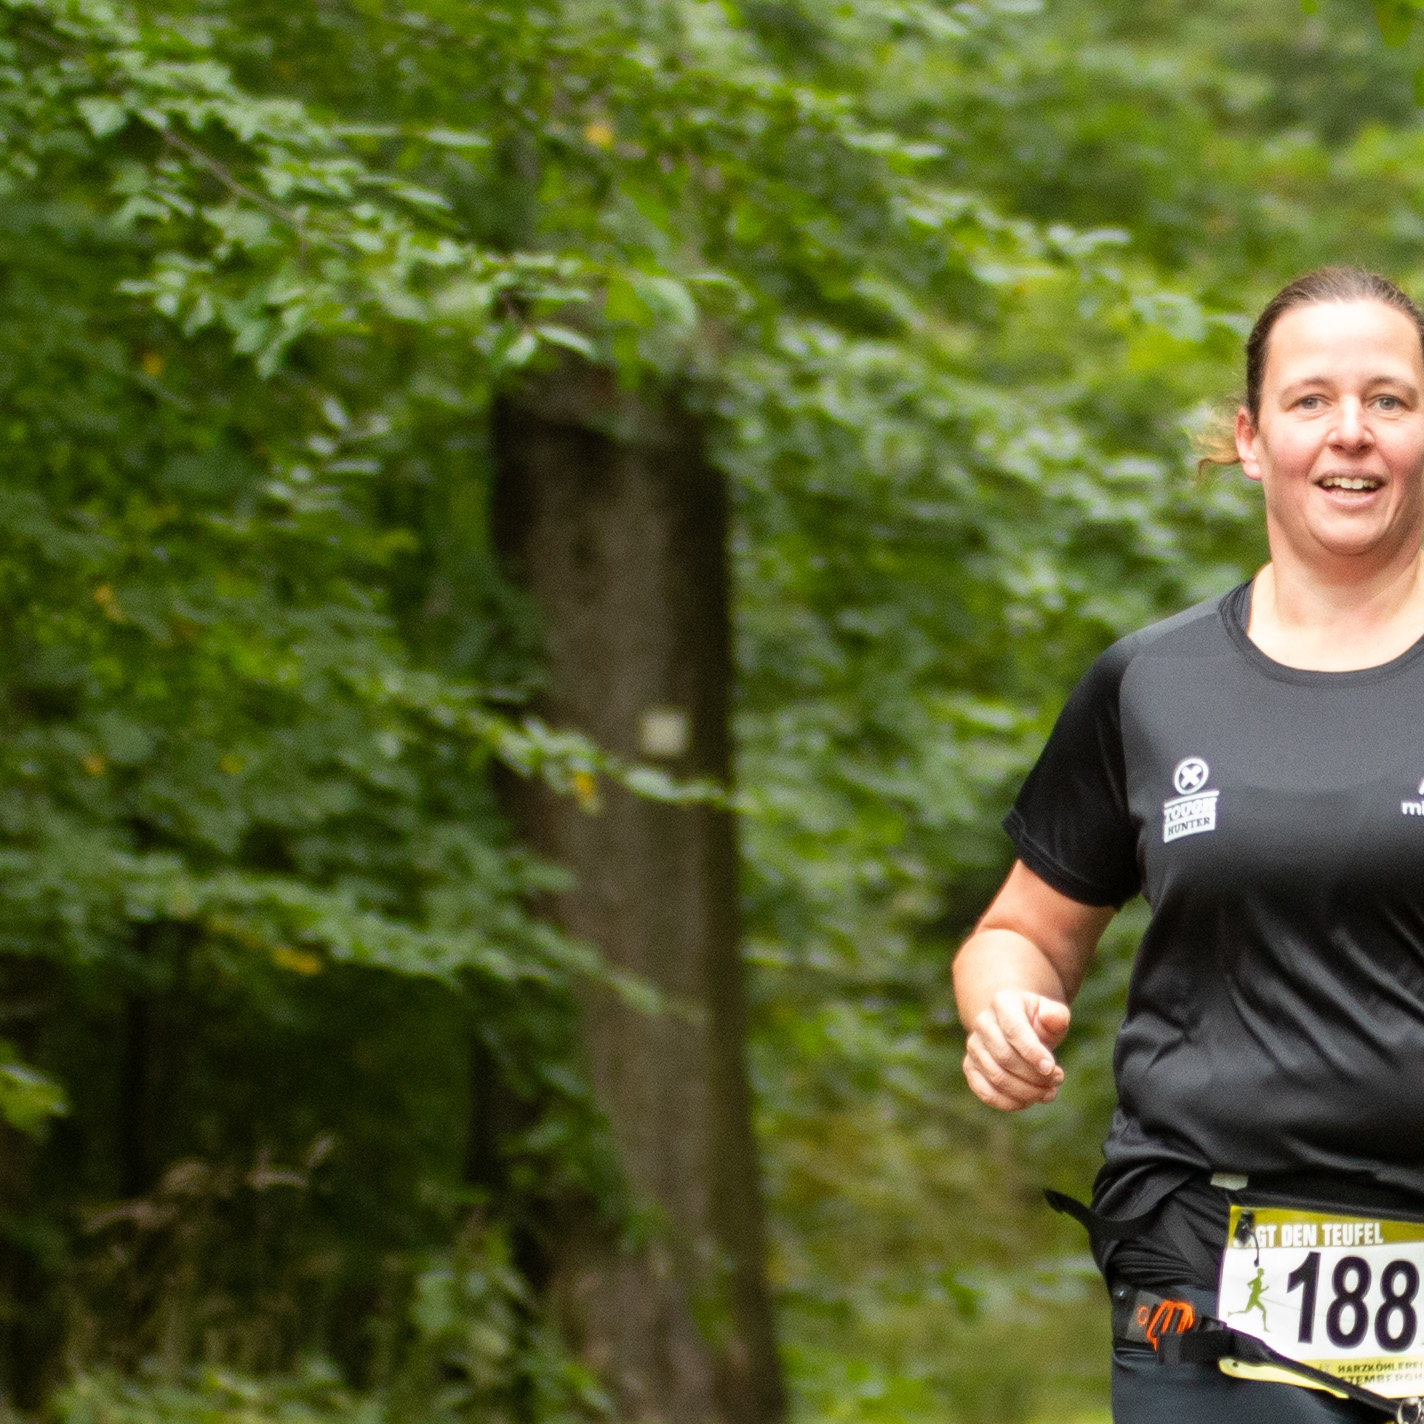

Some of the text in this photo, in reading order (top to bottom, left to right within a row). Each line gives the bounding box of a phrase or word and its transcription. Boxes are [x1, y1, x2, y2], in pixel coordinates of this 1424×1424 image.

[1168, 816, 1211, 836] HUNTER
[1232, 1222, 1384, 1248] GT DEN TEUFEL
[1286, 1251, 1420, 1352] 188
